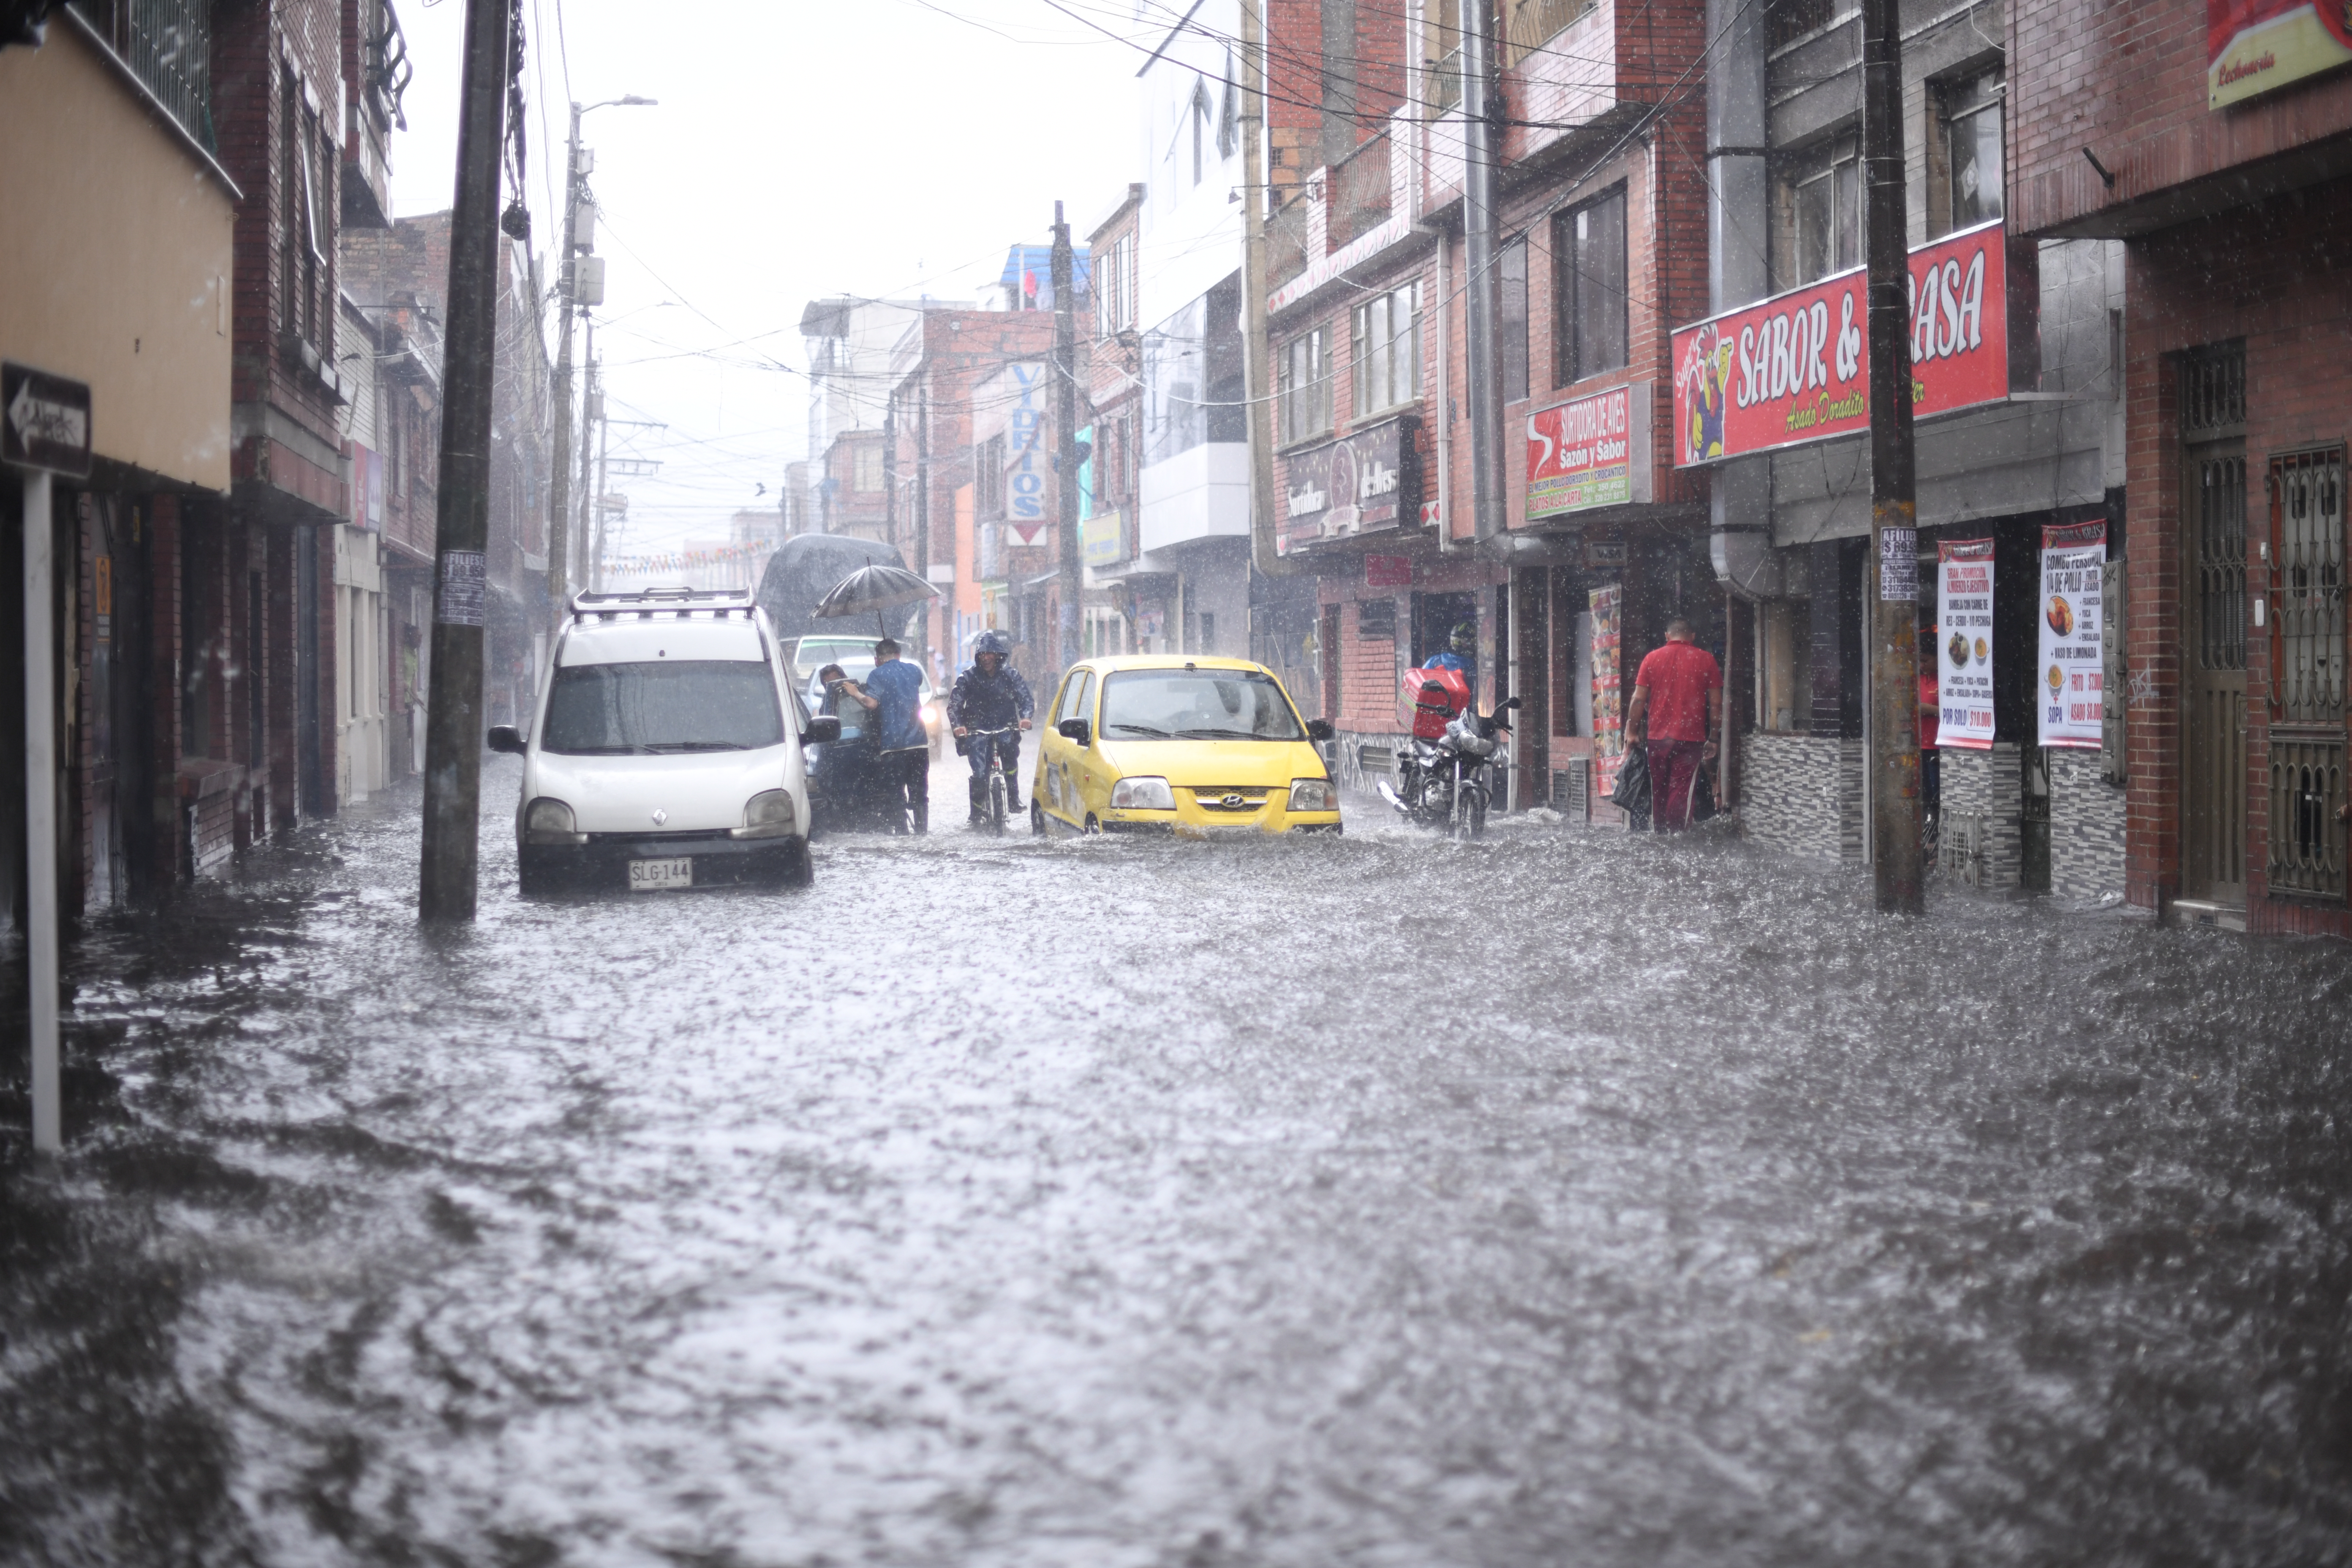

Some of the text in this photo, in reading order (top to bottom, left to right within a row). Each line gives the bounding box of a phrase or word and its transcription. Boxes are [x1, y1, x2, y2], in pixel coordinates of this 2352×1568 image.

[1737, 299, 1828, 408] SABOR
[1836, 290, 1860, 384] &
[1676, 337, 1696, 398] Super
[1785, 399, 1816, 434] Asado
[1819, 388, 1864, 425] Doradito
[1561, 392, 1625, 446] SURTIDORA DE AVES
[1013, 366, 1041, 517] VIDRIOS
[1560, 438, 1625, 469] Sazón y Sabor
[1529, 465, 1626, 494] EL MEJOR POLLO DORADITO Y CROCANTICO
[1598, 483, 1608, 491] 350
[1611, 480, 1625, 490] 4622
[1289, 461, 1396, 517] Surtidora de Aves
[1529, 489, 1582, 513] PLATOS A LA CARTA
[1595, 494, 1603, 502] 320
[2082, 523, 2105, 539] BRASA
[1595, 549, 1622, 559] VISA
[1884, 541, 1891, 553] $
[2047, 551, 2102, 570] COMBO PERSONAL
[1947, 568, 1959, 579] GRAN
[2086, 570, 2098, 580] FRITO
[1947, 579, 1989, 593] ALMUERZO EJECUTIVO
[2055, 572, 2063, 593] DE
[2064, 571, 2081, 593] POLLO
[2084, 582, 2099, 592] ASADO
[1949, 599, 1963, 610] BANDEJA
[1971, 599, 1983, 610] CARNE
[1983, 599, 1988, 610] DE
[2082, 597, 2100, 606] FRANCESA
[1955, 615, 1966, 626] CERDO
[1975, 615, 1991, 626] PECHUGA
[2082, 610, 2091, 618] YUCA
[2082, 621, 2093, 629] ARROZ
[2082, 633, 2100, 641] ENSALADA
[2055, 647, 2065, 659] VASO
[2066, 647, 2072, 659] DE
[2073, 647, 2097, 659] LIMONADA
[1951, 676, 1964, 685] FRANCESA
[2072, 674, 2083, 691] FRITO
[1946, 688, 1954, 697] ARROZ
[1943, 708, 1991, 727] POR SOLO $10.000
[2048, 706, 2062, 724] SOPA
[2071, 703, 2085, 721] ASADO
